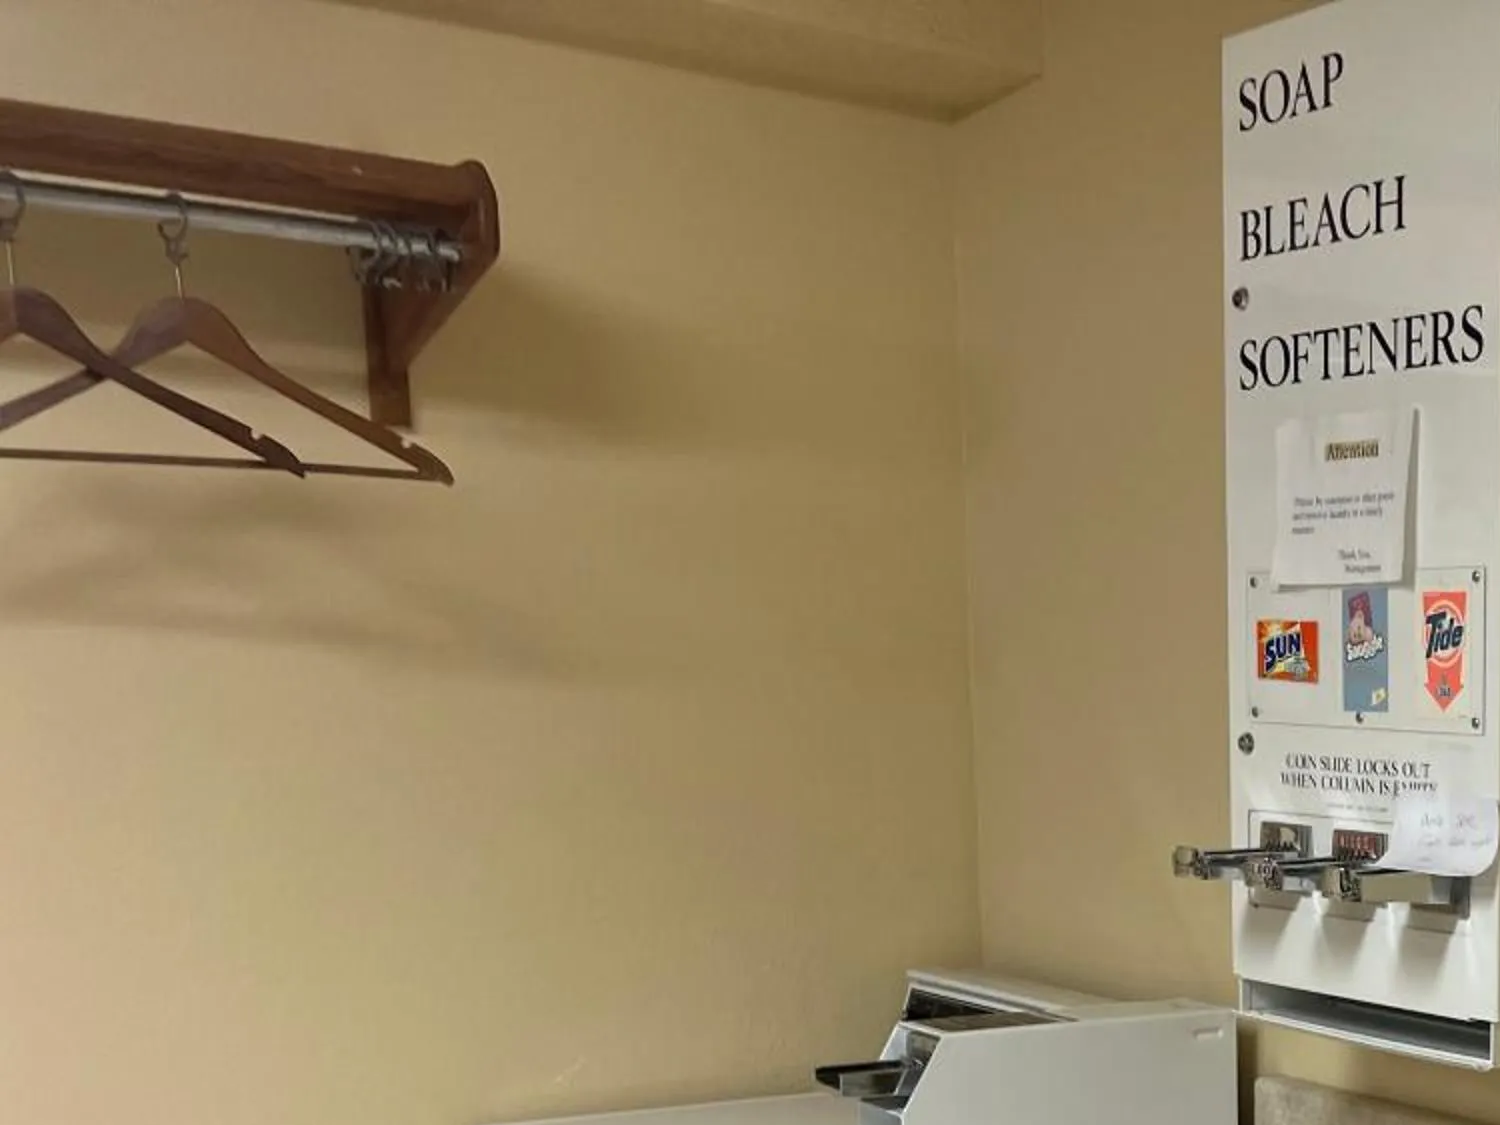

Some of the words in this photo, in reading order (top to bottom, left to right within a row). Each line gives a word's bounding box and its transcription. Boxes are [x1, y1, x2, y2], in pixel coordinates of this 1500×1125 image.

[1239, 52, 1344, 132] SOAP
[1240, 174, 1407, 262] BLEACH
[1239, 304, 1485, 391] SOFTENERS
[1265, 632, 1301, 672] SUN
[1425, 611, 1464, 659] Tide
[1281, 771, 1317, 789] WHEN
[1321, 775, 1375, 795] COLUMN
[1285, 752, 1316, 769] COIN
[1319, 755, 1352, 774] SLIDE
[1357, 758, 1399, 777] LOCKS
[1402, 759, 1431, 779] OUT
